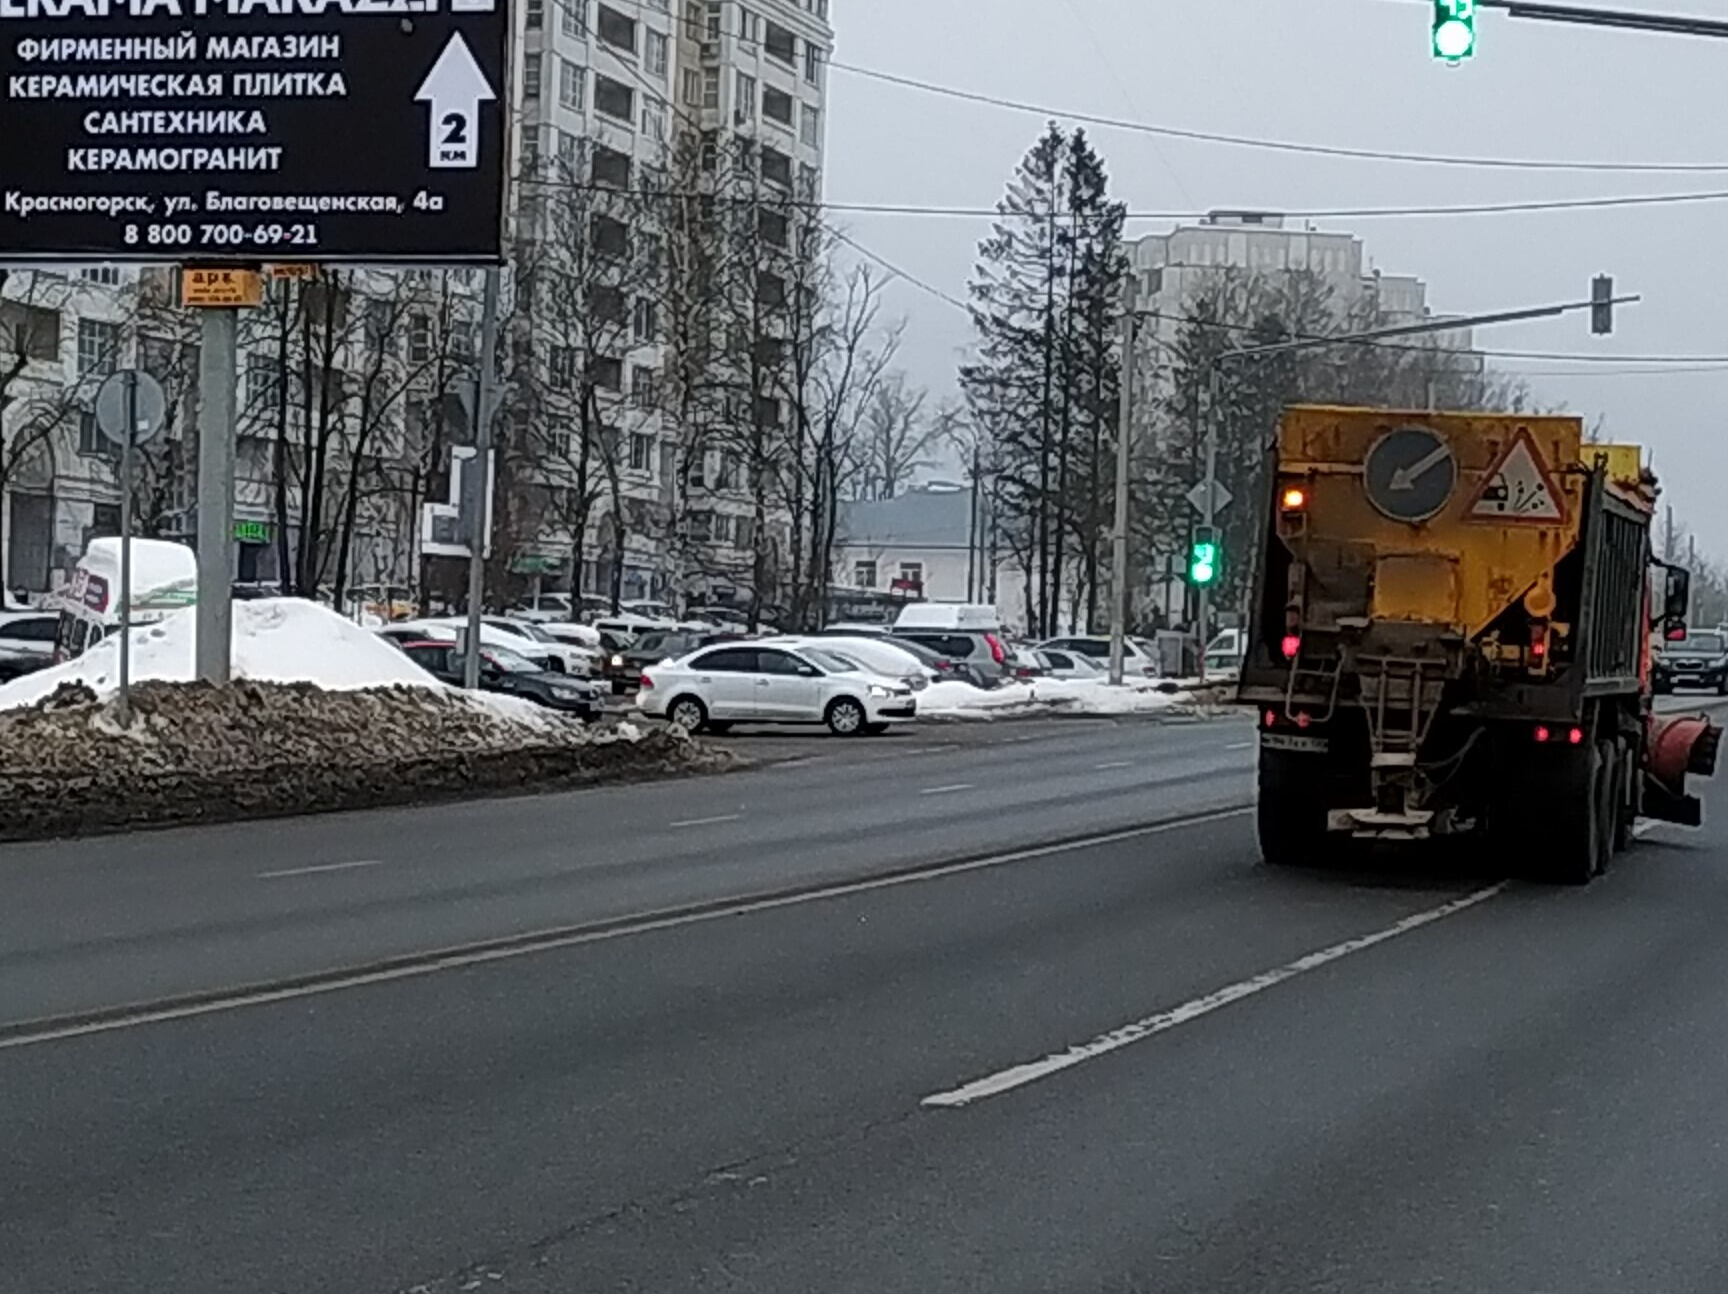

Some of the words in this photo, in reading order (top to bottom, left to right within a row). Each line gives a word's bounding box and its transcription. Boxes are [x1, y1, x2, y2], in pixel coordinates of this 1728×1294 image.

[17, 31, 197, 61] ФИРМЕННЫЙ
[205, 35, 339, 59] МАГАЗИН
[9, 74, 223, 98] КЕРАМИЧЕСКАЯ
[233, 73, 346, 96] ПЛИТКА
[83, 111, 266, 134] САНТЕХНИКА
[441, 112, 467, 144] 2
[68, 147, 282, 171] КЕРАМОГРАНИТ
[5, 191, 155, 217] Красногорск,
[164, 196, 198, 217] ул.
[206, 191, 404, 214] Благовещенская,
[413, 190, 443, 210] 4а
[124, 224, 139, 244] 8
[147, 224, 192, 244] 800
[200, 224, 317, 244] 700-69-21
